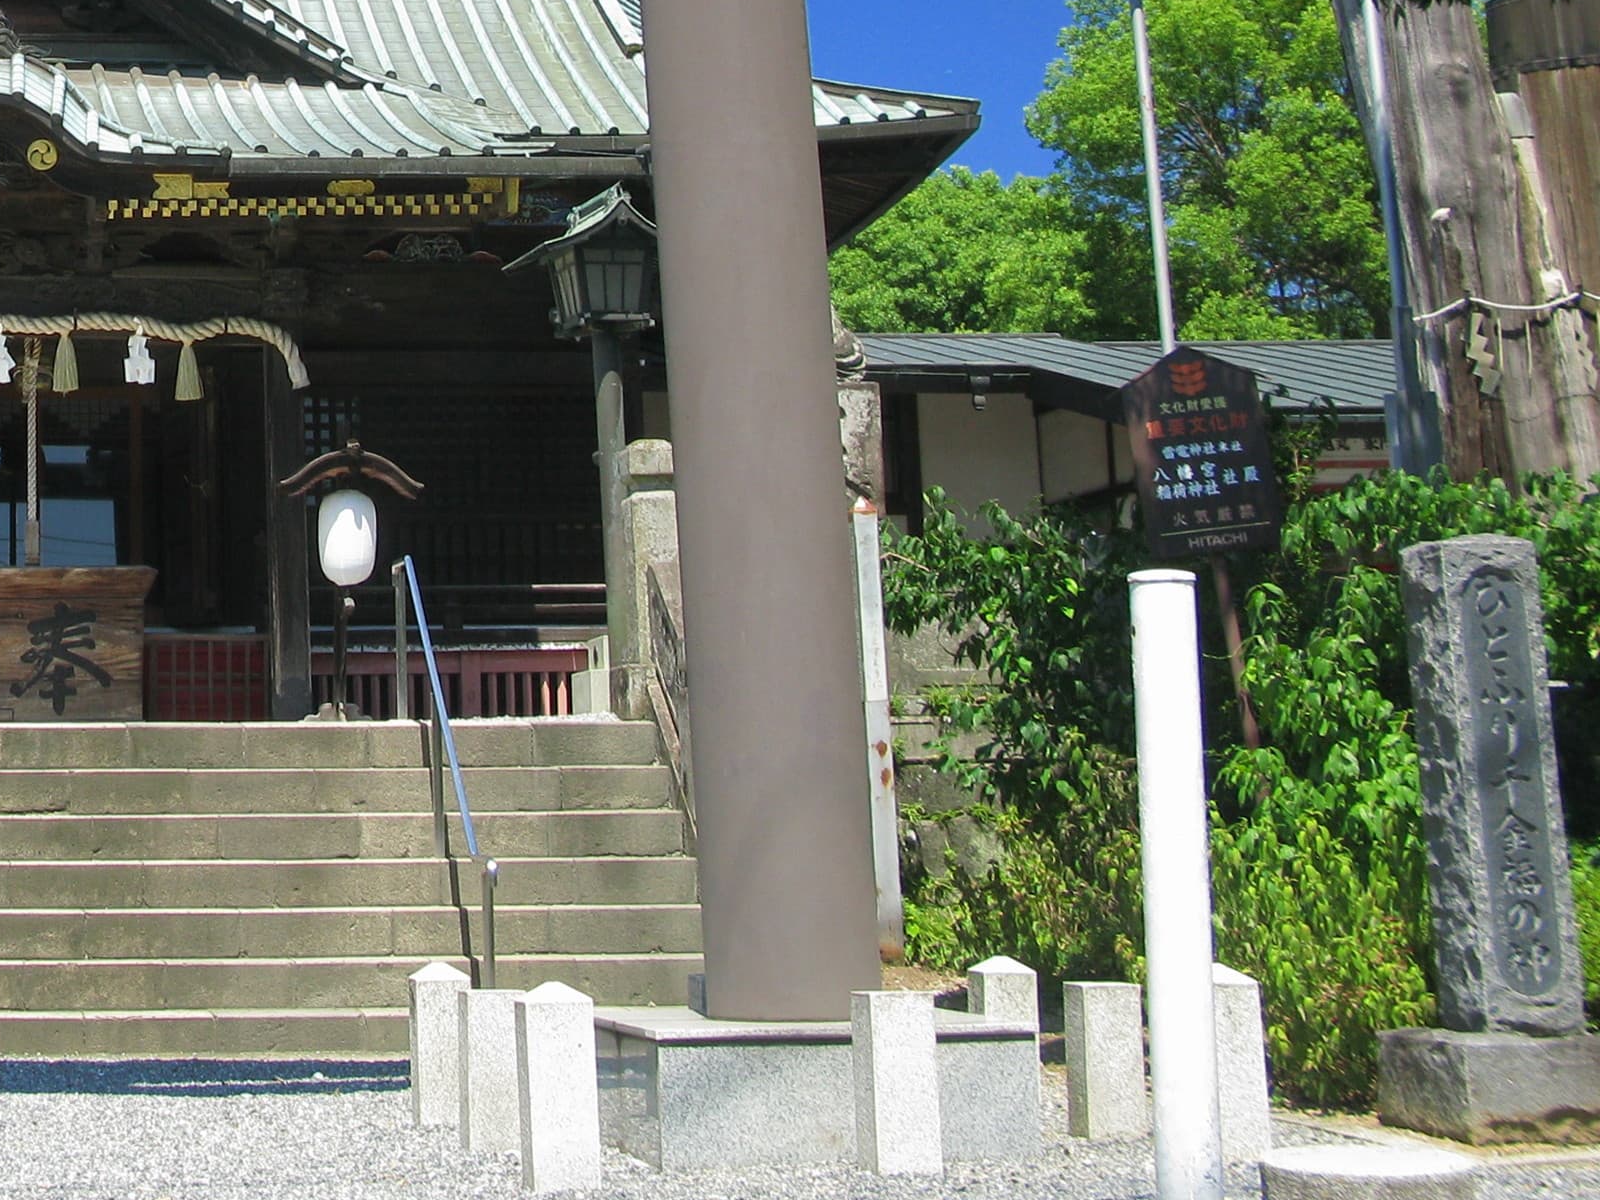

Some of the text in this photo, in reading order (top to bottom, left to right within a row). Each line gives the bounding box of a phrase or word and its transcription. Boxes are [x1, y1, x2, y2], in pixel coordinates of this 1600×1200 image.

[1146, 413, 1247, 439] 重要文化財
[1188, 533, 1248, 549] HITACHI
